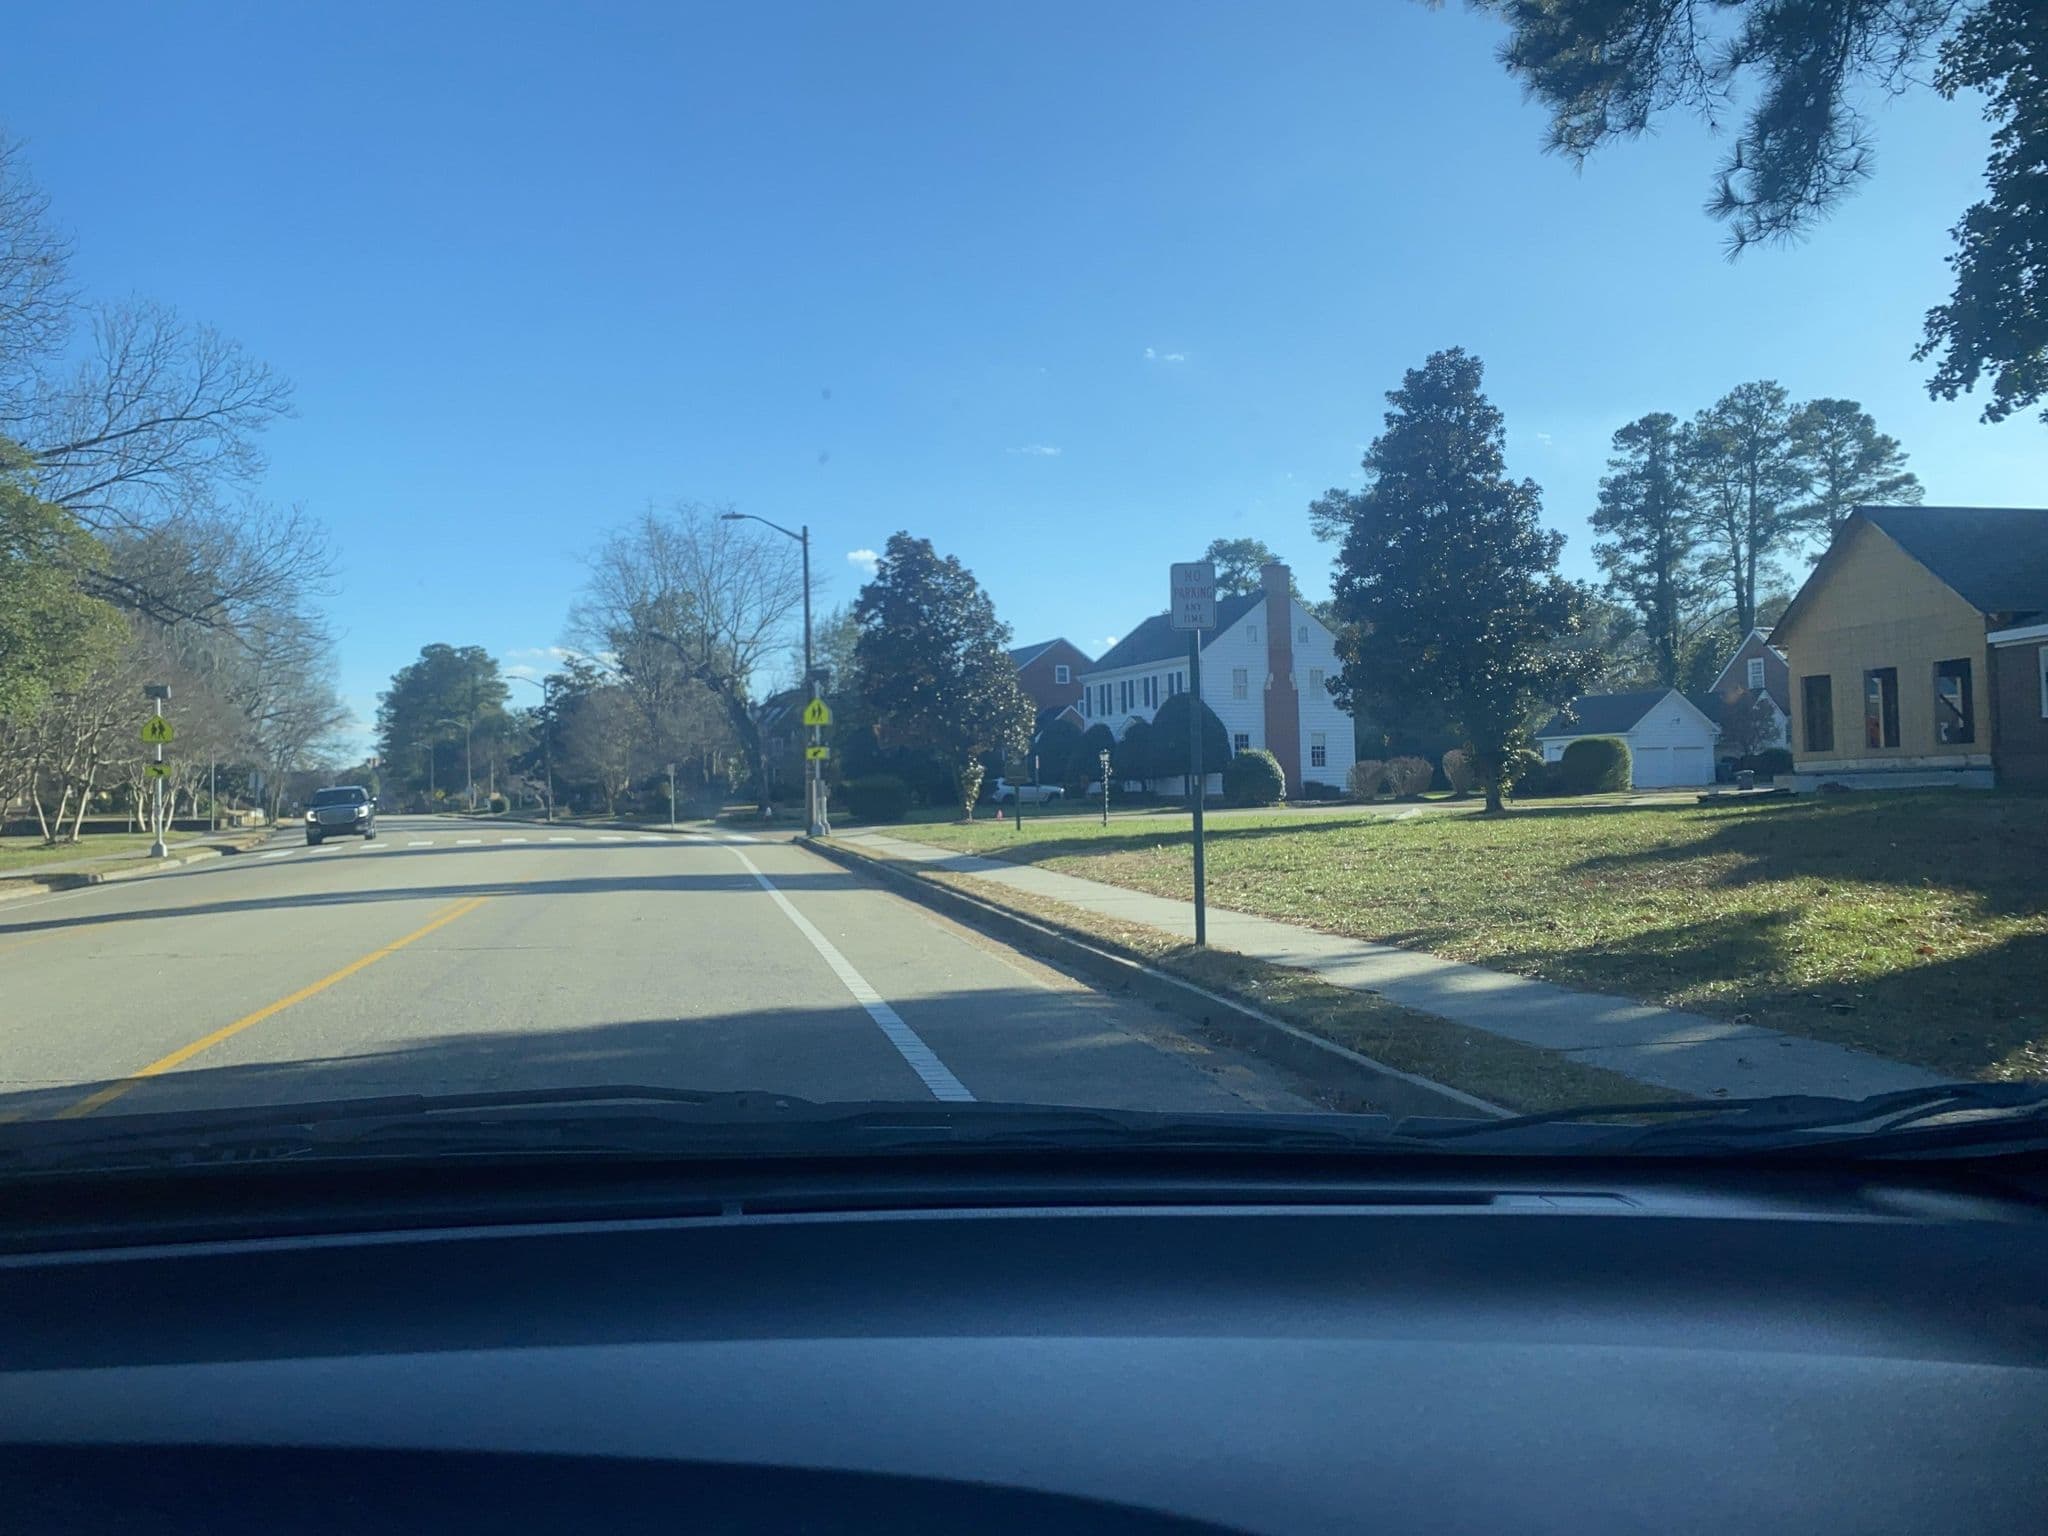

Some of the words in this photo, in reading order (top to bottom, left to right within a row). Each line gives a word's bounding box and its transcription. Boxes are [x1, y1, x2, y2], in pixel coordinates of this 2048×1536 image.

[1184, 568, 1201, 583] NO
[1174, 585, 1213, 600] PARKING
[1184, 603, 1201, 612] ANY
[1184, 614, 1205, 623] TIME
